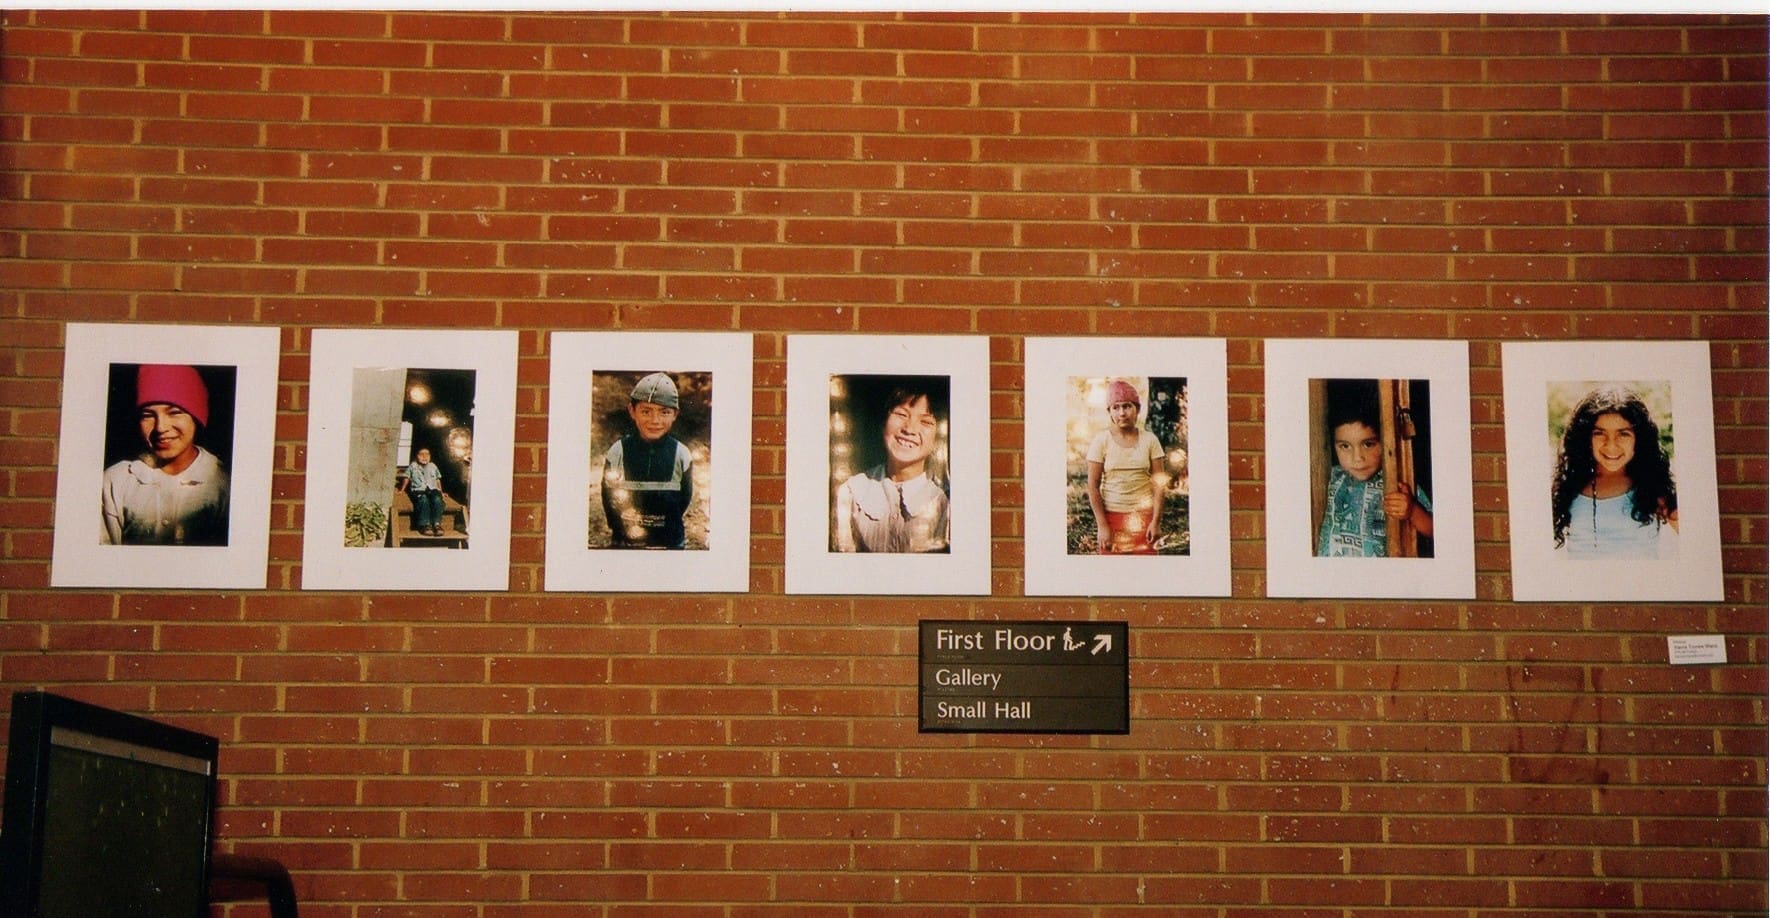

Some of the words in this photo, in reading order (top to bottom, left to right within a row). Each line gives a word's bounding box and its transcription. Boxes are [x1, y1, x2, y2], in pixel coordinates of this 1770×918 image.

[937, 629, 984, 650] First
[995, 628, 1056, 651] Floor
[935, 668, 1002, 690] Gallery
[937, 701, 986, 718] Small
[995, 702, 1031, 719] Hall
